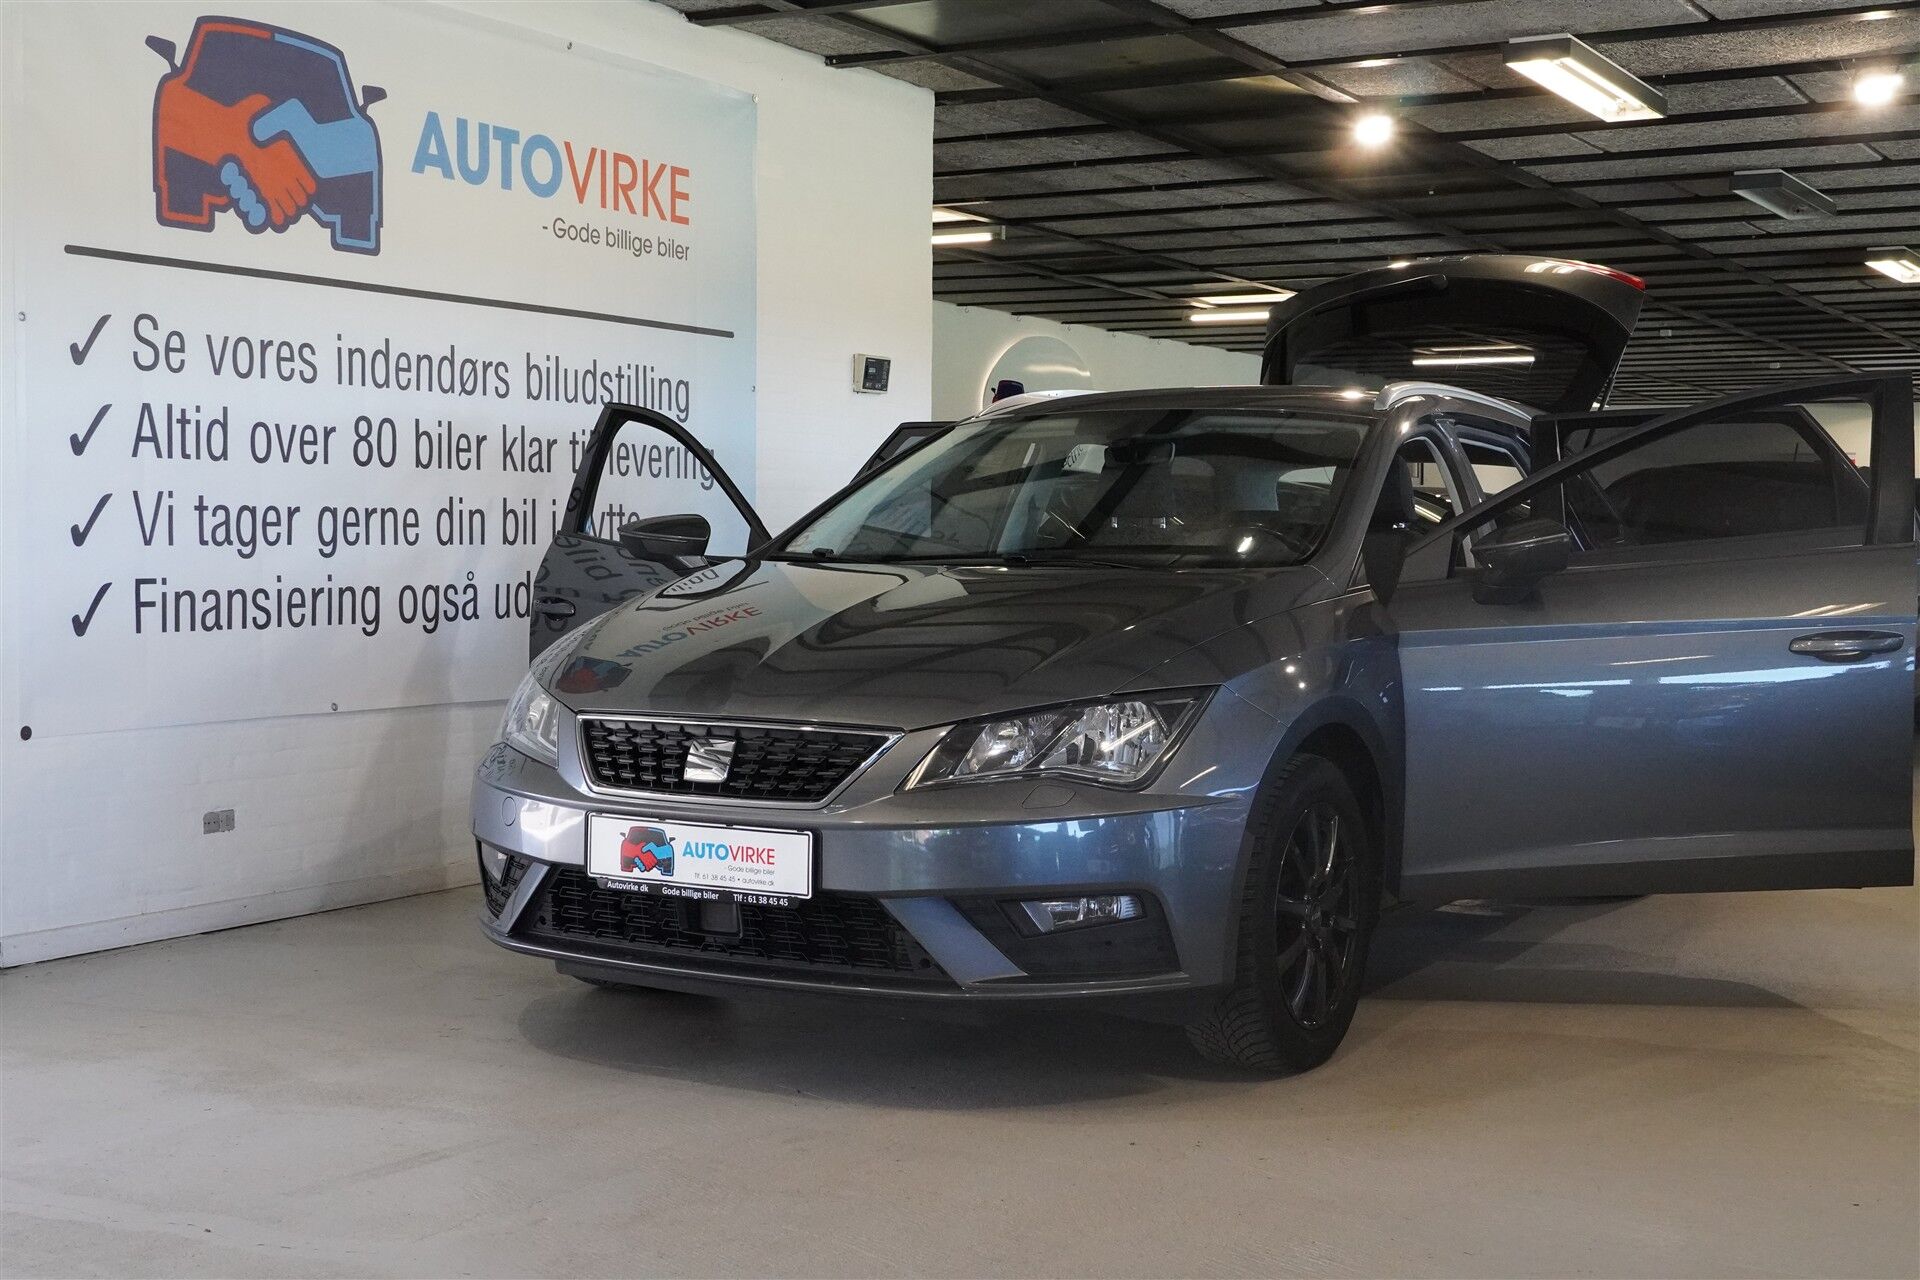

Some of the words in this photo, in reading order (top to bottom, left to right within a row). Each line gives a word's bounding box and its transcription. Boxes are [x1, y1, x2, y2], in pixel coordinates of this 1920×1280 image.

[411, 111, 690, 226] AUTOVIRKE
[553, 217, 600, 245] Gode
[605, 226, 653, 258] billige
[657, 236, 690, 261] biler
[132, 312, 186, 374] Se
[205, 333, 318, 385] vores
[336, 333, 511, 397] indendørs
[525, 351, 690, 424] biludstilling
[131, 402, 229, 462] Altid
[249, 421, 337, 467] over
[352, 415, 398, 469] 80
[414, 417, 488, 471] biler
[502, 423, 558, 474] klar
[132, 490, 174, 547] Vi
[193, 494, 301, 560] tager
[317, 505, 420, 559] gerne
[436, 495, 486, 547] din
[502, 496, 537, 547] bil
[551, 498, 557, 540] i
[134, 573, 381, 638] Finansiering
[398, 560, 480, 636] også
[682, 841, 775, 865] AUTOVIRKE
[607, 880, 639, 891] Autovirke
[640, 884, 649, 893] dk
[662, 886, 680, 896] Gode
[681, 888, 702, 900] billige
[703, 891, 719, 900] biler
[733, 893, 743, 902] Tlf
[748, 895, 757, 904] 61
[758, 896, 768, 905] 38
[769, 897, 778, 905] 45
[779, 898, 789, 907] 45
